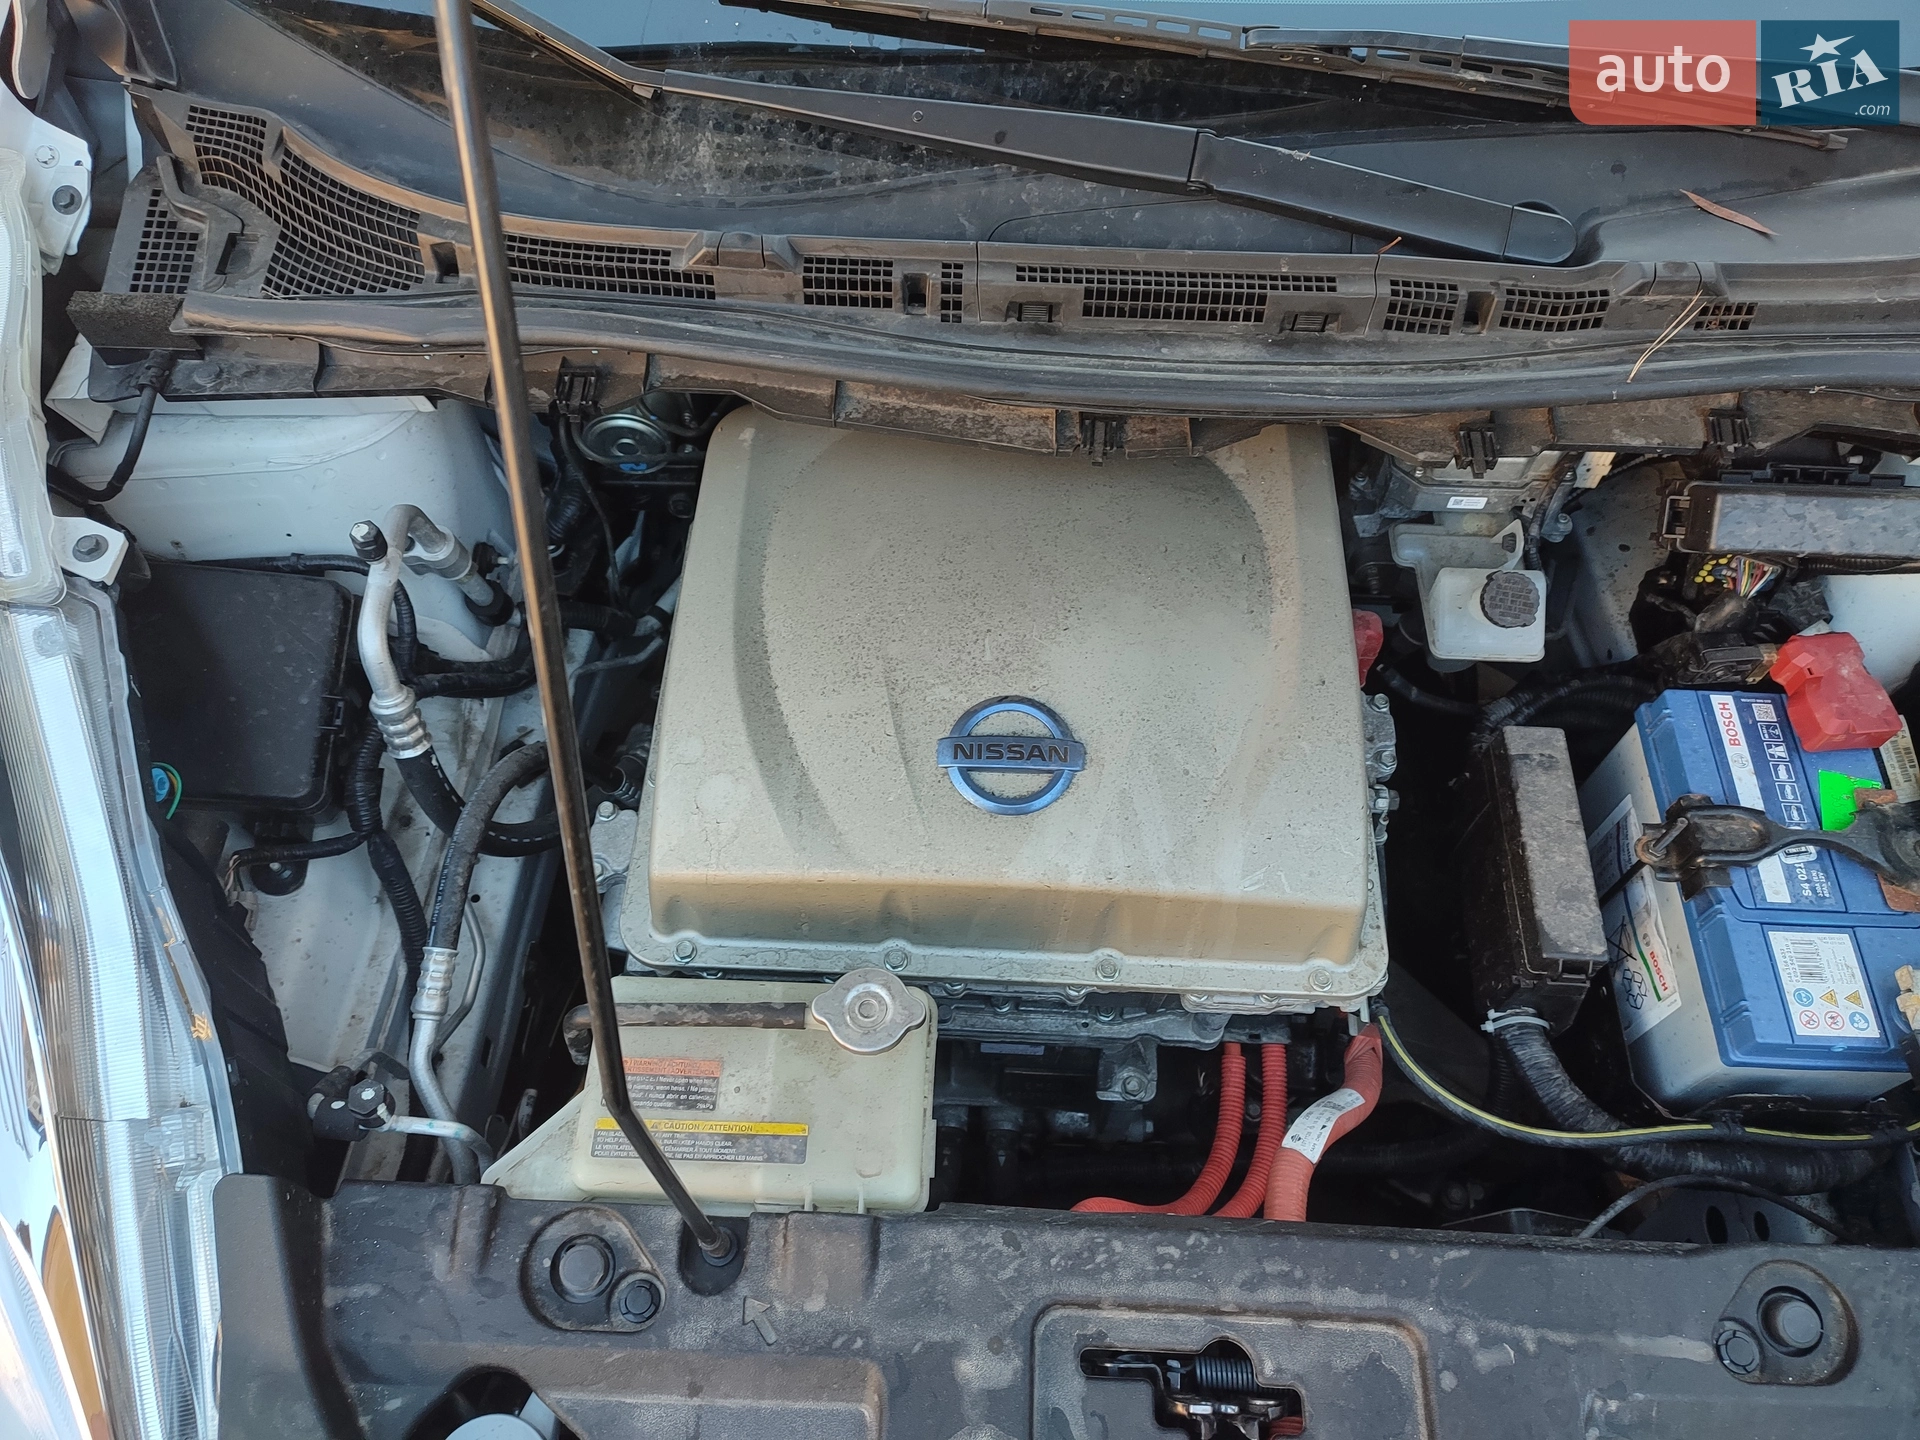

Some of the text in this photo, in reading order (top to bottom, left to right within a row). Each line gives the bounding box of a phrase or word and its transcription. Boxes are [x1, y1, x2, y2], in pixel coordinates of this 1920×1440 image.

[1718, 702, 1742, 746] BOSCH
[953, 743, 1069, 763] NISSAN
[1794, 862, 1808, 880] 021
[1800, 883, 1812, 897] S4
[1649, 950, 1669, 992] BOSCH
[664, 1122, 700, 1131] CAUTION
[708, 1123, 753, 1132] ATTENTION
